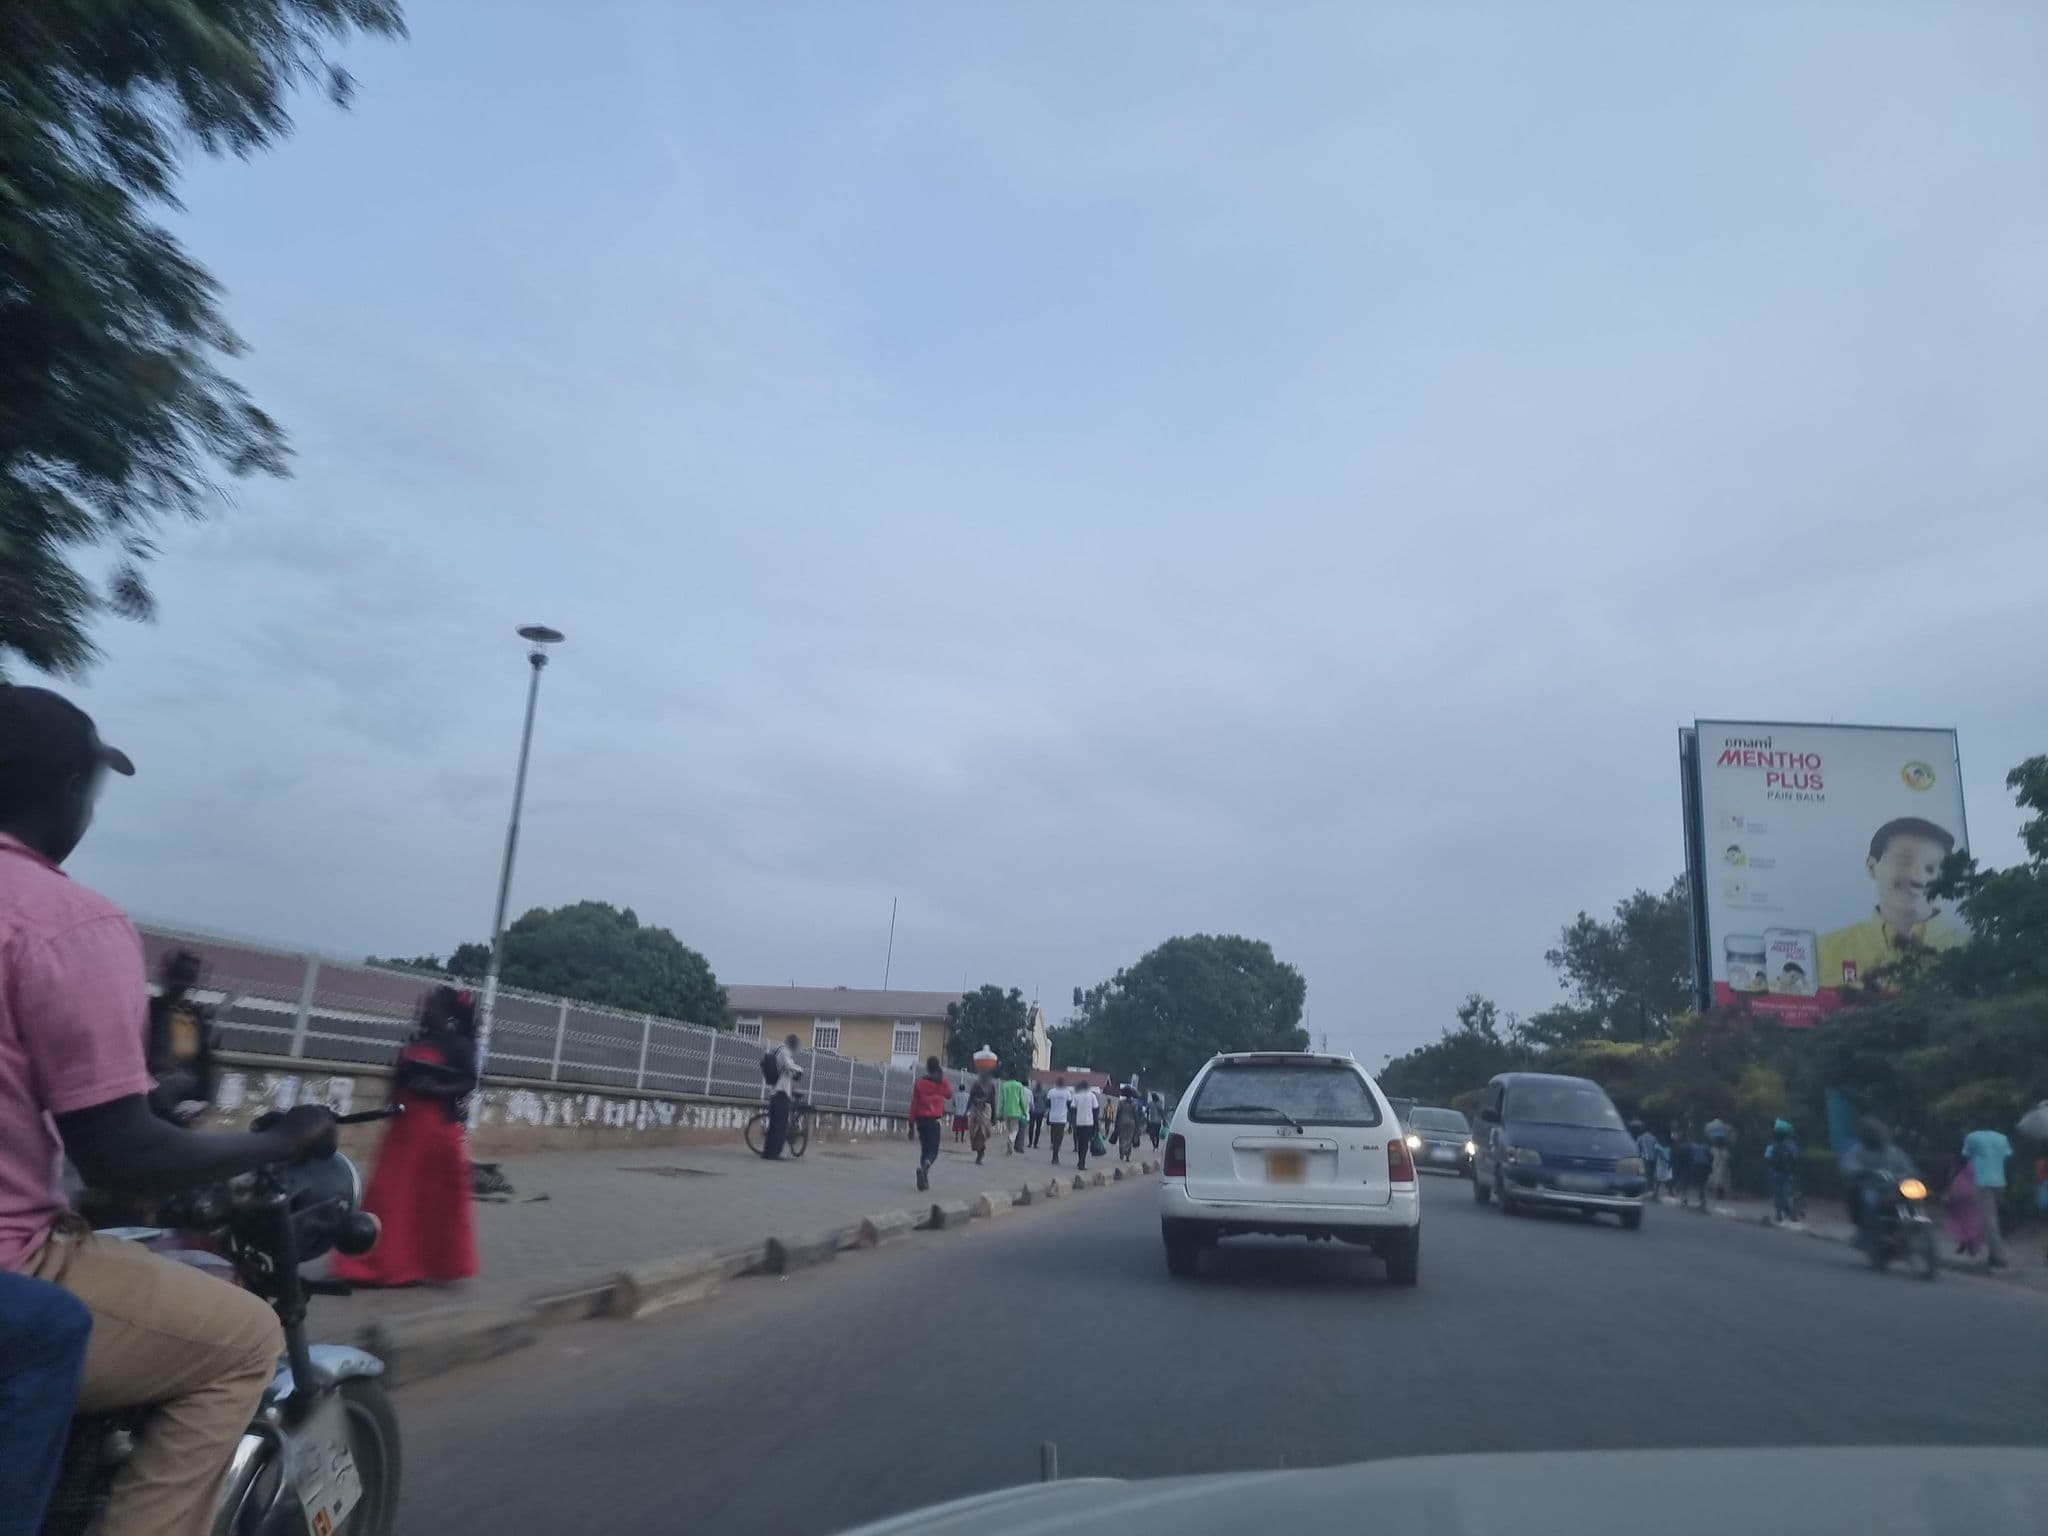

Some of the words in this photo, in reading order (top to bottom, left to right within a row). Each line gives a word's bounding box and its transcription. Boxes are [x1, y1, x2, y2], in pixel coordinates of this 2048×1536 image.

[1717, 750, 1821, 769] MENTHO
[1767, 772, 1824, 790] PLUS
[1767, 791, 1793, 801] PAIN
